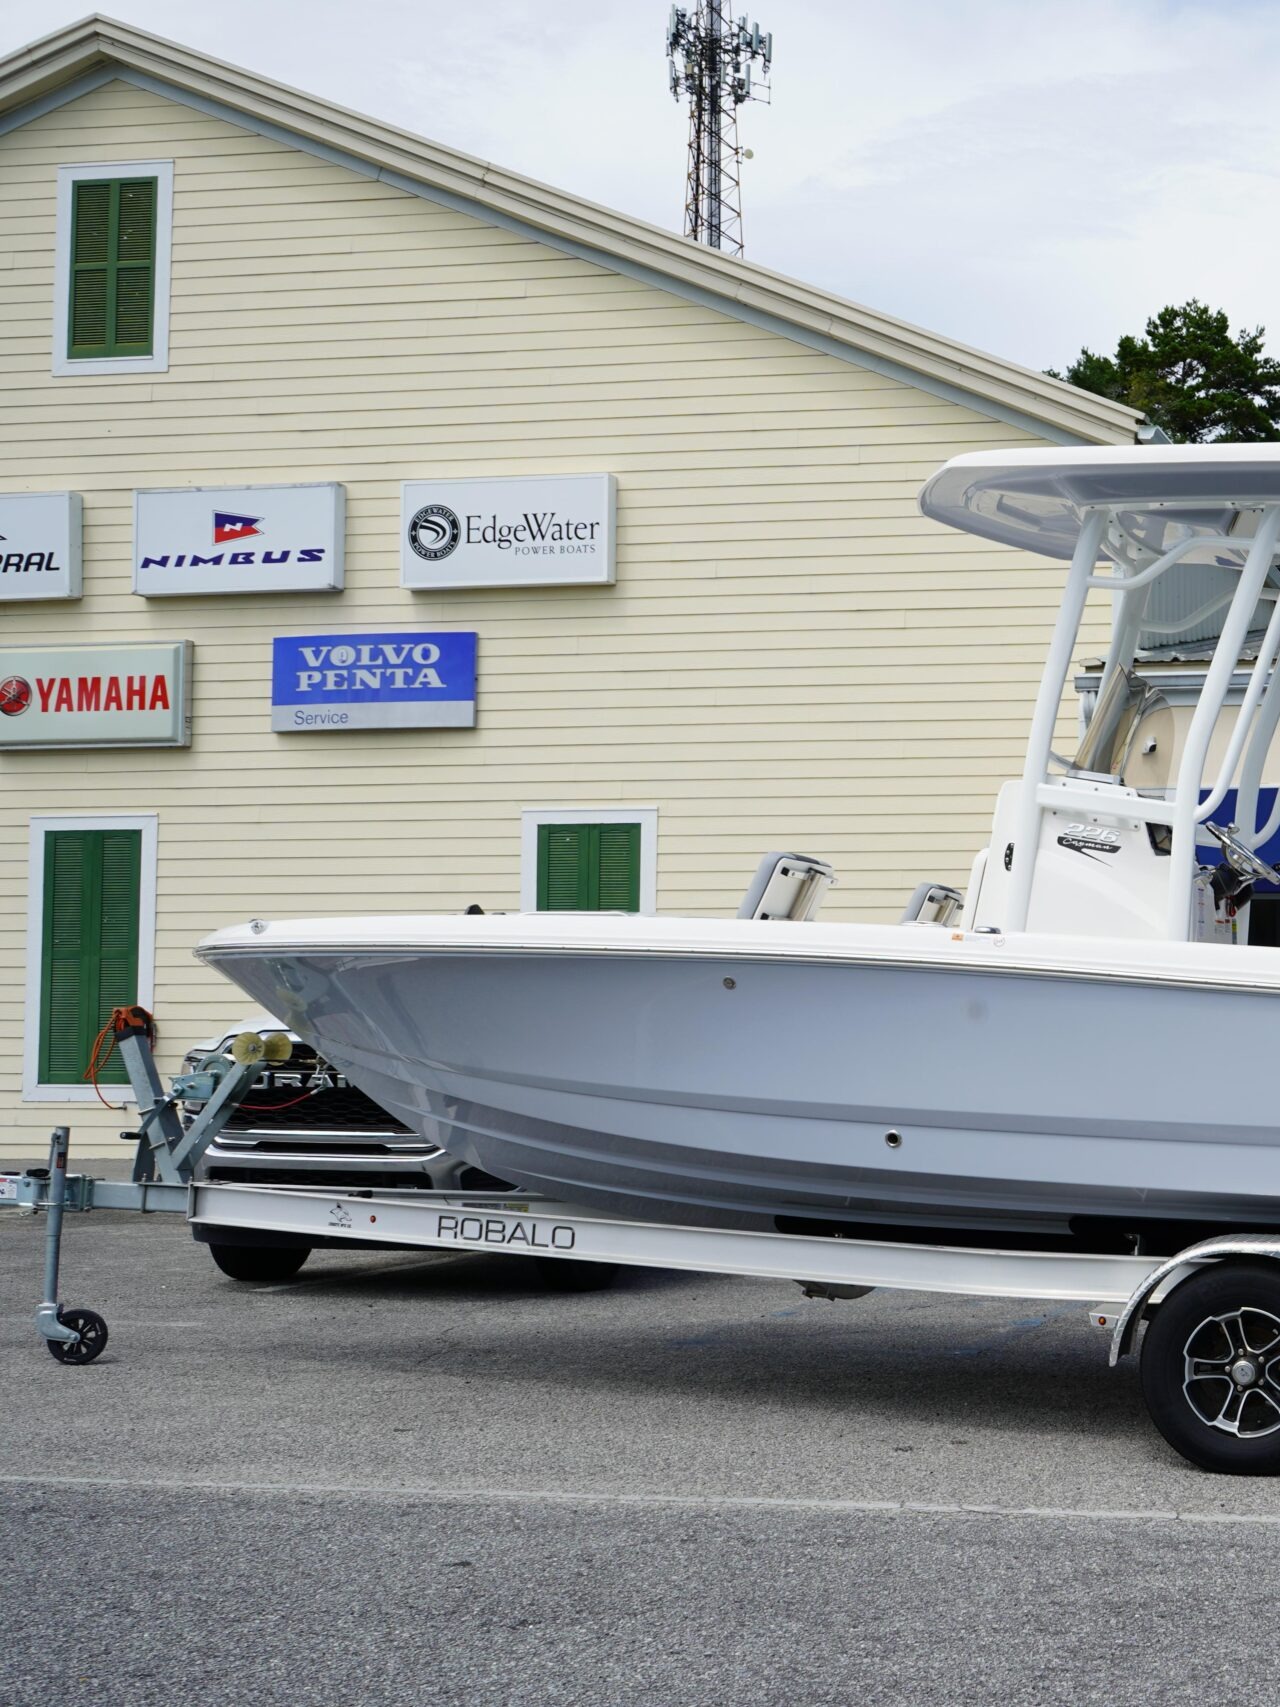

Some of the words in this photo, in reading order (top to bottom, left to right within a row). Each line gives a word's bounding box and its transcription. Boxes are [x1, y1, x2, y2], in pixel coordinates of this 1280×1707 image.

[465, 512, 600, 550] EdgeWater
[140, 548, 326, 569] NIMBUS
[514, 546, 556, 556] POWER
[559, 544, 596, 554] BOATS
[0, 551, 61, 573] RAL
[298, 643, 441, 668] VOLVO
[295, 668, 448, 692] PENTA
[35, 674, 170, 713] YAMAHA
[294, 709, 349, 726] Service
[1063, 823, 1121, 844] 226
[437, 1215, 576, 1250] ROBALO
